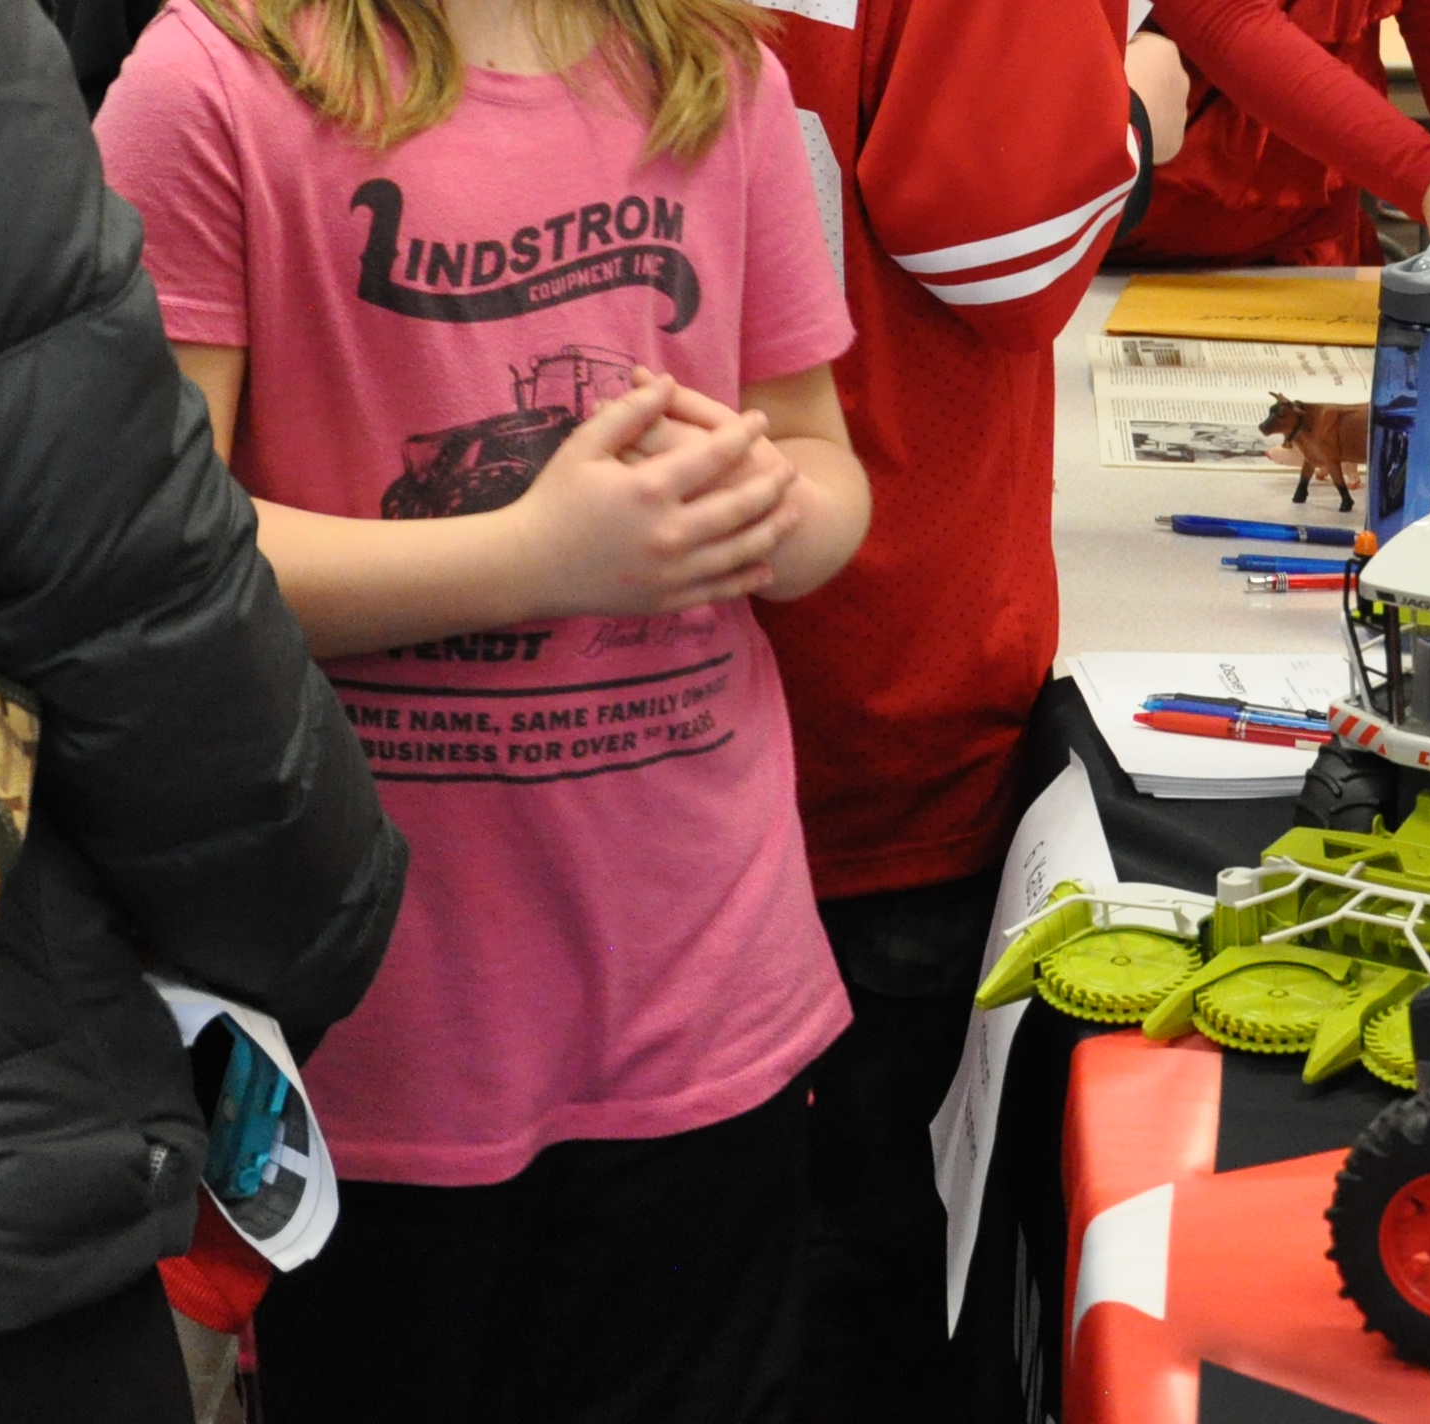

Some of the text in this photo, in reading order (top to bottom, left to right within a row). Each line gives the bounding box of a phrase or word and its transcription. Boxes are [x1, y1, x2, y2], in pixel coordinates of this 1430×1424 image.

[350, 178, 684, 317] LINDSTROM
[527, 259, 630, 304] EQUIPMENT
[348, 703, 400, 730] AME
[409, 710, 501, 737] NAME,
[511, 707, 589, 733] SAME
[597, 693, 679, 724] FAMILY
[366, 737, 498, 765] BUSINESS
[508, 737, 562, 763] FOR
[572, 731, 637, 759] OVER
